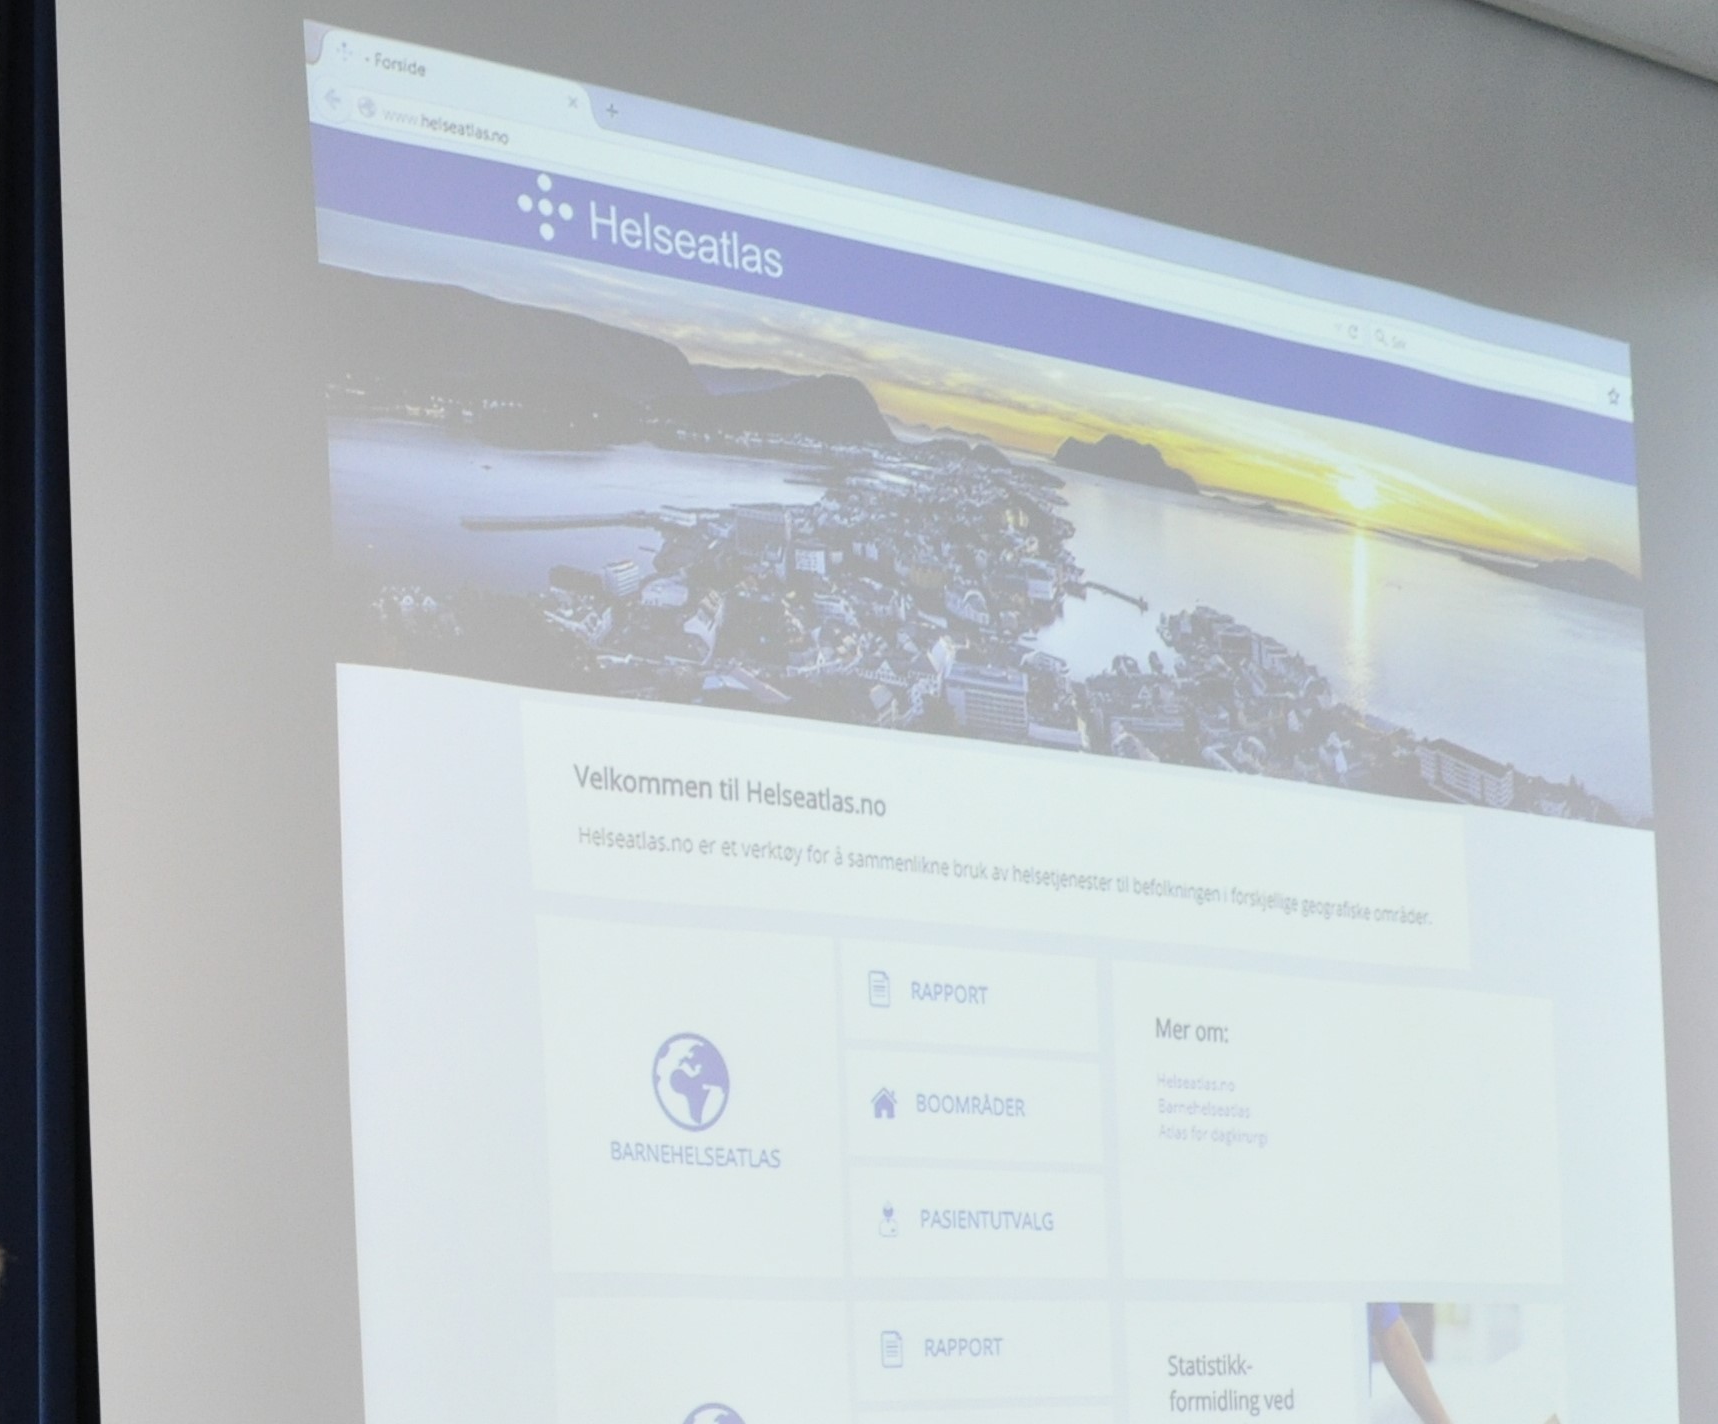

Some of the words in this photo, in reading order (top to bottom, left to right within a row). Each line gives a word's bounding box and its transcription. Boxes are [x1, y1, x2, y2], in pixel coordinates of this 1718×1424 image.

[374, 52, 426, 78] Forside
[590, 200, 783, 278] Helseatlas
[574, 764, 713, 800] Velkommen
[720, 778, 739, 802] til
[747, 781, 887, 817] Helseatlas.no
[578, 826, 693, 855] Helseatlas.no
[699, 839, 716, 856] er
[721, 840, 738, 858] et
[742, 841, 803, 867] verktøy
[807, 843, 830, 865] for
[835, 845, 843, 866] å
[848, 852, 949, 877] sammenlikne
[953, 860, 988, 881] bruk
[991, 866, 1009, 882] av
[1012, 864, 1112, 893] helsetjenester
[1116, 875, 1130, 893] til
[1133, 878, 1221, 905] befolkningen
[1231, 886, 1298, 914] forskjellige
[1301, 896, 1370, 921] geografiske
[911, 981, 988, 1005] RAPPORT
[1155, 1017, 1190, 1041] Mer
[1195, 1024, 1229, 1044] om:
[916, 1092, 1025, 1118] BOOMRÅDER
[1191, 1125, 1207, 1142] for
[610, 1140, 781, 1169] BARNEHELSEATLAS
[920, 1209, 1054, 1232] PASIENTUTVALG
[924, 1337, 1003, 1359] RAPPORT
[1167, 1353, 1253, 1377] Statistikk-
[1169, 1389, 1260, 1416] formidling
[1264, 1388, 1295, 1411] ved
